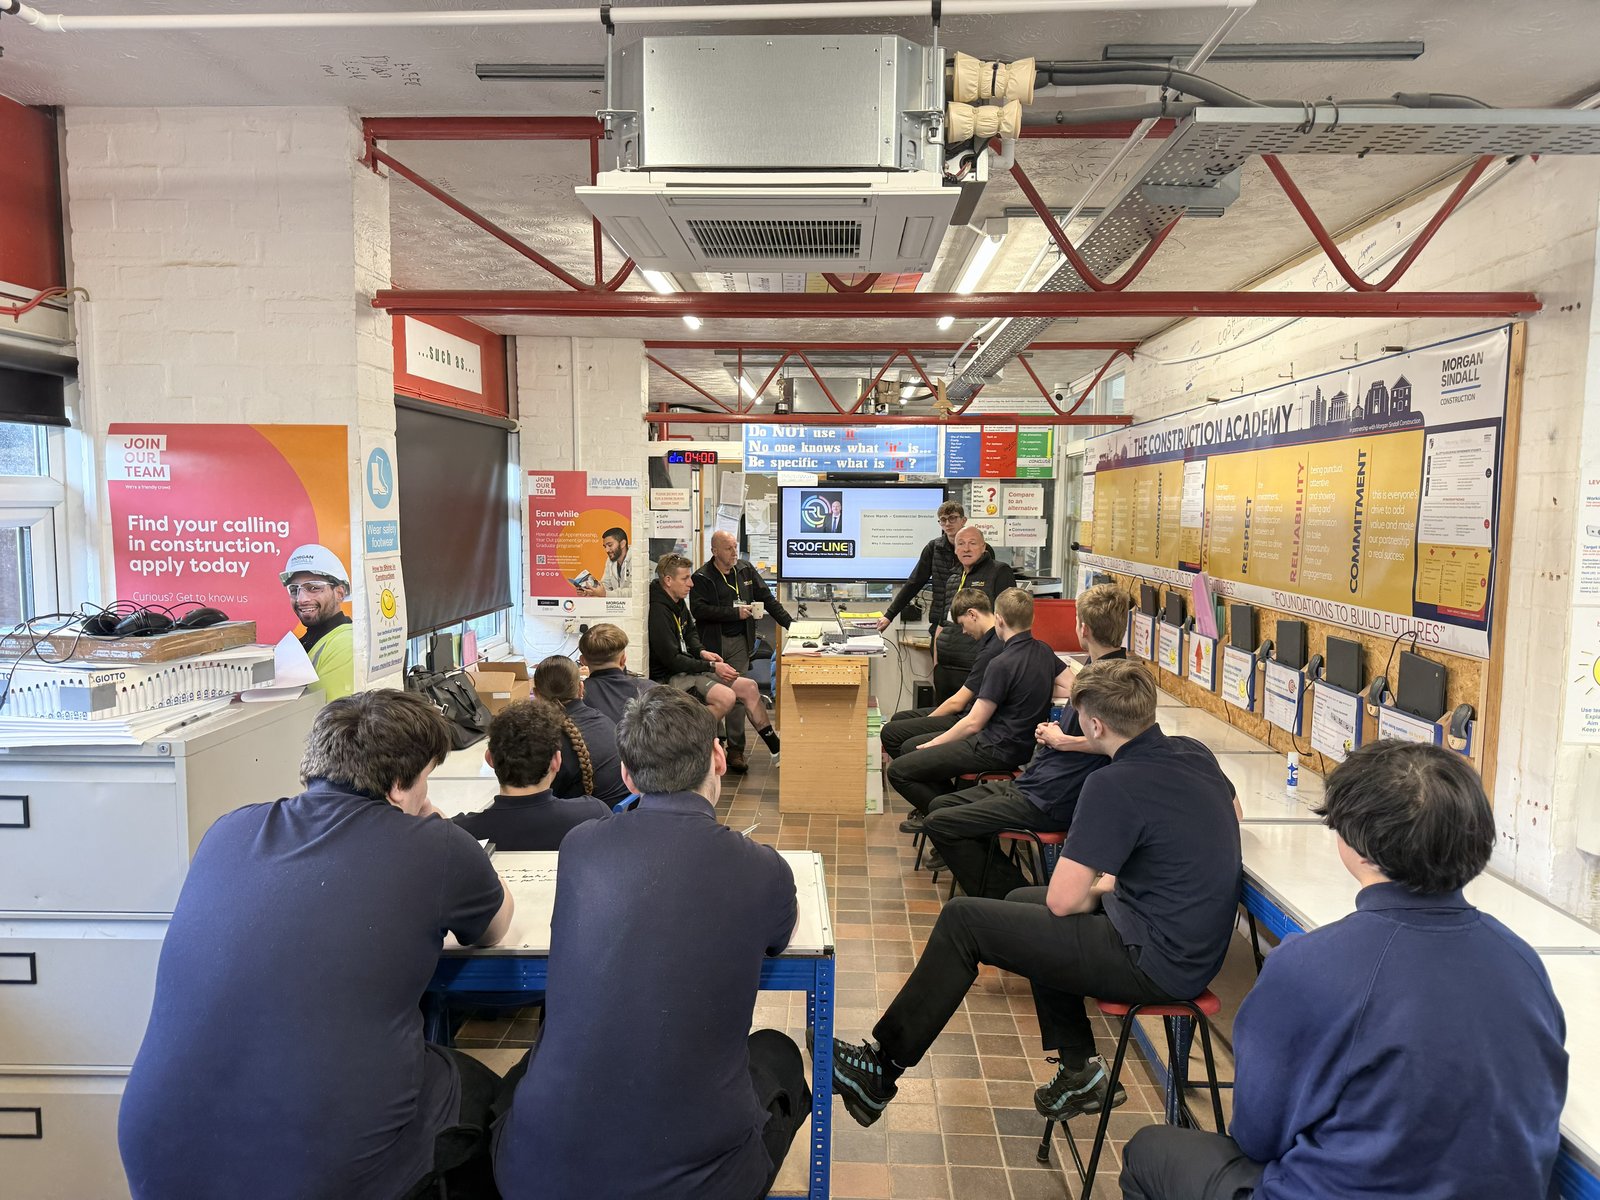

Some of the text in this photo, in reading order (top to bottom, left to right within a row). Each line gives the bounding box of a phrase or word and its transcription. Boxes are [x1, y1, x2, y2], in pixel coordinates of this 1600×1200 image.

[418, 346, 475, 373] ...such as...
[1442, 352, 1483, 373] MORGAN
[1441, 368, 1480, 387] SINDALL
[1440, 393, 1476, 406] CONSTRUCTION
[748, 425, 767, 437] Do
[773, 427, 808, 437] NOT
[813, 430, 835, 438] use
[1134, 437, 1147, 457] THE
[1149, 418, 1223, 453] CONSTRUCTION
[1225, 403, 1293, 443] ACADEMY
[1376, 422, 1389, 430] Morgan
[124, 438, 160, 449] JOIN
[748, 440, 769, 452] No
[774, 444, 795, 453] one
[801, 442, 841, 453] knows
[847, 443, 879, 453] what
[908, 443, 931, 453] is...
[124, 452, 157, 464] OUR
[685, 452, 715, 463] 04:00
[748, 456, 765, 467] Be
[770, 457, 818, 470] specific
[836, 458, 868, 468] what
[873, 458, 885, 468] is
[124, 466, 165, 477] TEAM
[1372, 489, 1418, 502] this is everyone's
[535, 510, 579, 518] Earn while
[1371, 504, 1405, 515] drive to add
[128, 515, 290, 538] Find your calling
[554, 519, 576, 527] learn
[1290, 462, 1304, 583] RELIABILITY
[1349, 449, 1367, 593] COMMITMENT
[1371, 519, 1415, 530] value and make
[367, 525, 381, 535] Wear
[1242, 496, 1252, 574] RESPECT
[128, 535, 281, 556] in construction,
[789, 542, 848, 552] ROOFLINE
[1369, 536, 1410, 549] our partnership
[1373, 550, 1384, 559] real
[1384, 551, 1405, 561] success
[129, 556, 250, 577] apply today
[133, 591, 248, 603] Curious? Get to know us
[1335, 604, 1348, 622] TO
[1351, 608, 1381, 630] BUILD
[95, 672, 126, 684] GIOTTO
